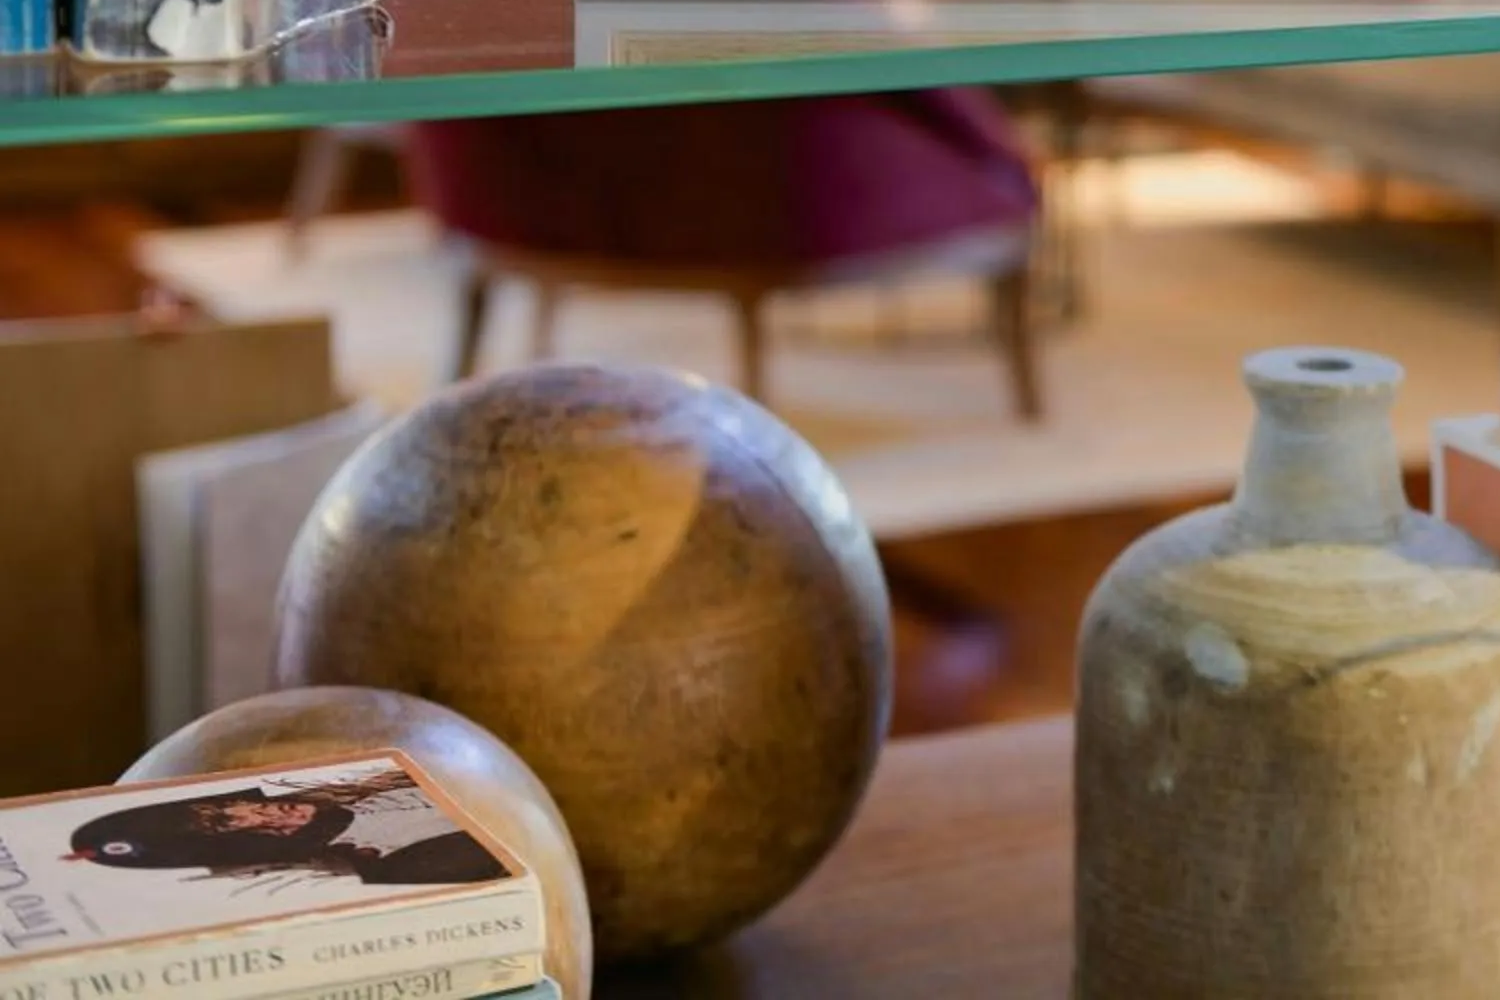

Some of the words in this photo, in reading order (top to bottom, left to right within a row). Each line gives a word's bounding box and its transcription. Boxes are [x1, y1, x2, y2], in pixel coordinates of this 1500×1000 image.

[312, 933, 418, 964] CHARLES
[425, 916, 525, 944] DICKENS
[68, 968, 146, 1000] TWO
[161, 948, 286, 988] CITIES
